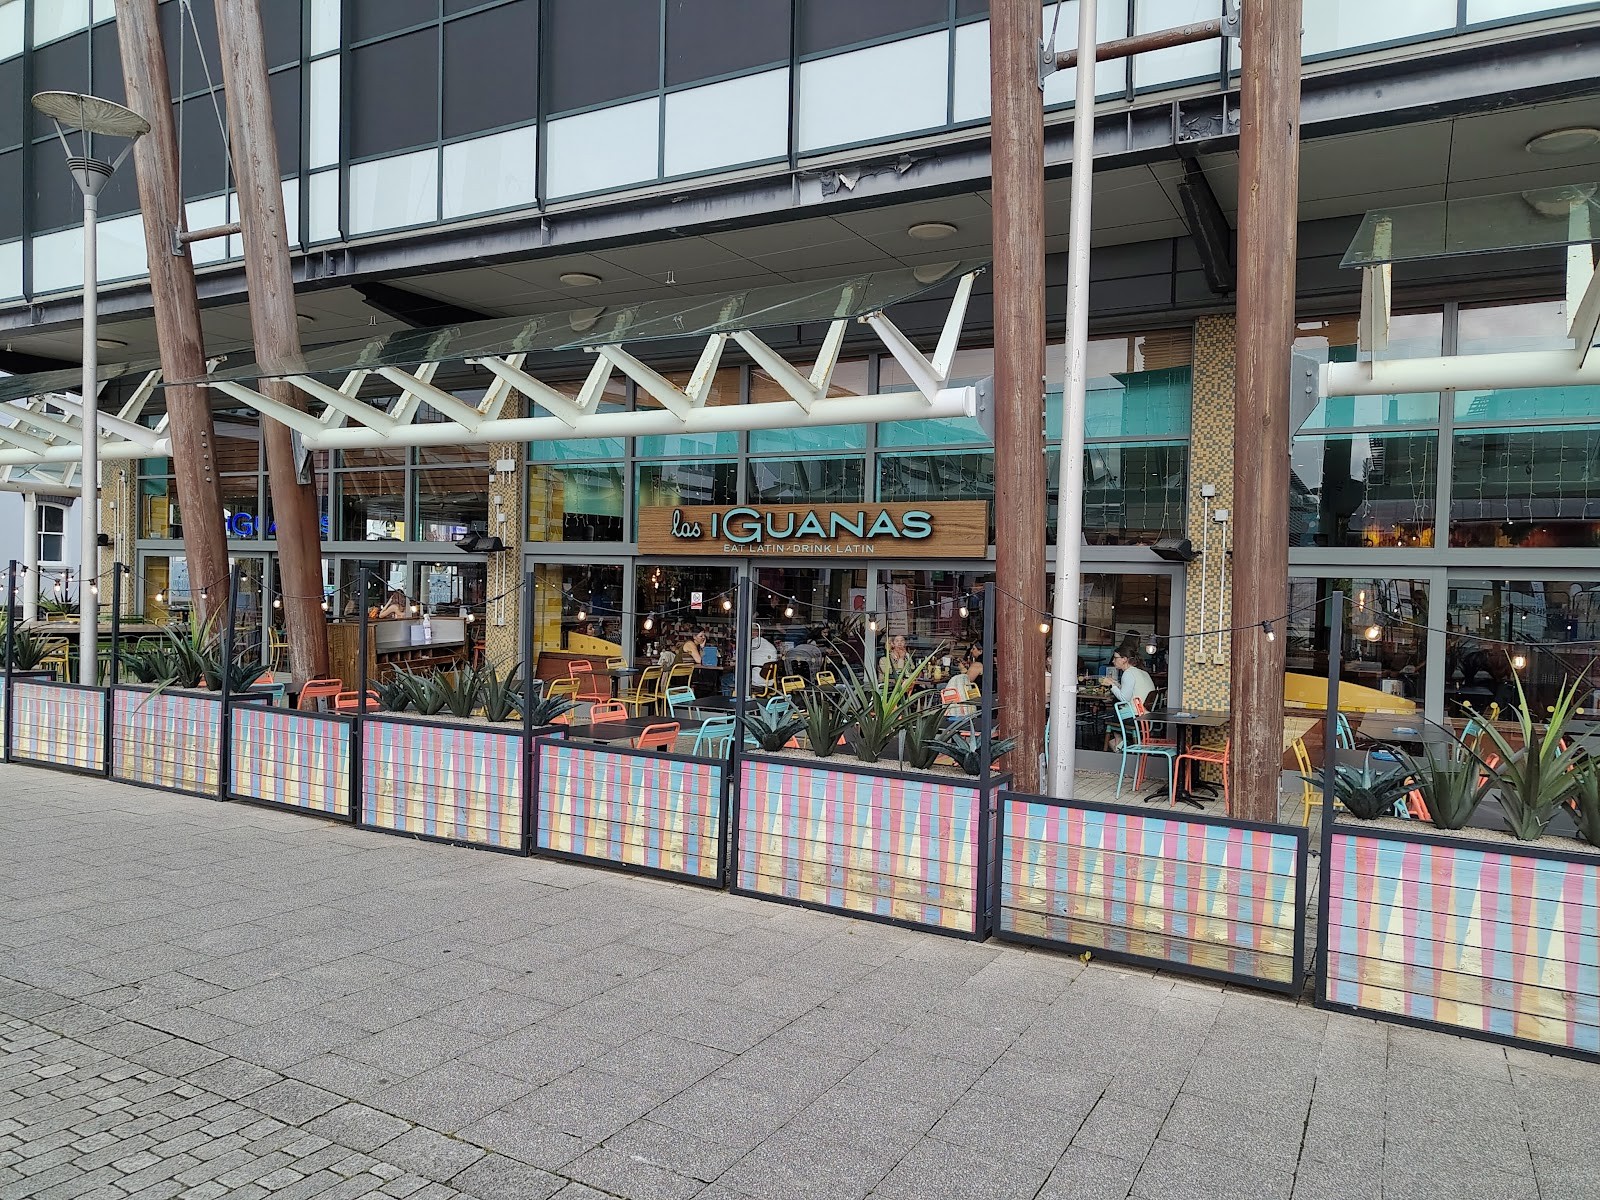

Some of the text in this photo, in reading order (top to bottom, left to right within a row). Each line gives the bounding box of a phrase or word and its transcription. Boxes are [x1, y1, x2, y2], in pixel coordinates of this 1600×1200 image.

[671, 507, 933, 543] las IGUANAS
[723, 544, 875, 553] EAT LATIN DRINK LATIN
